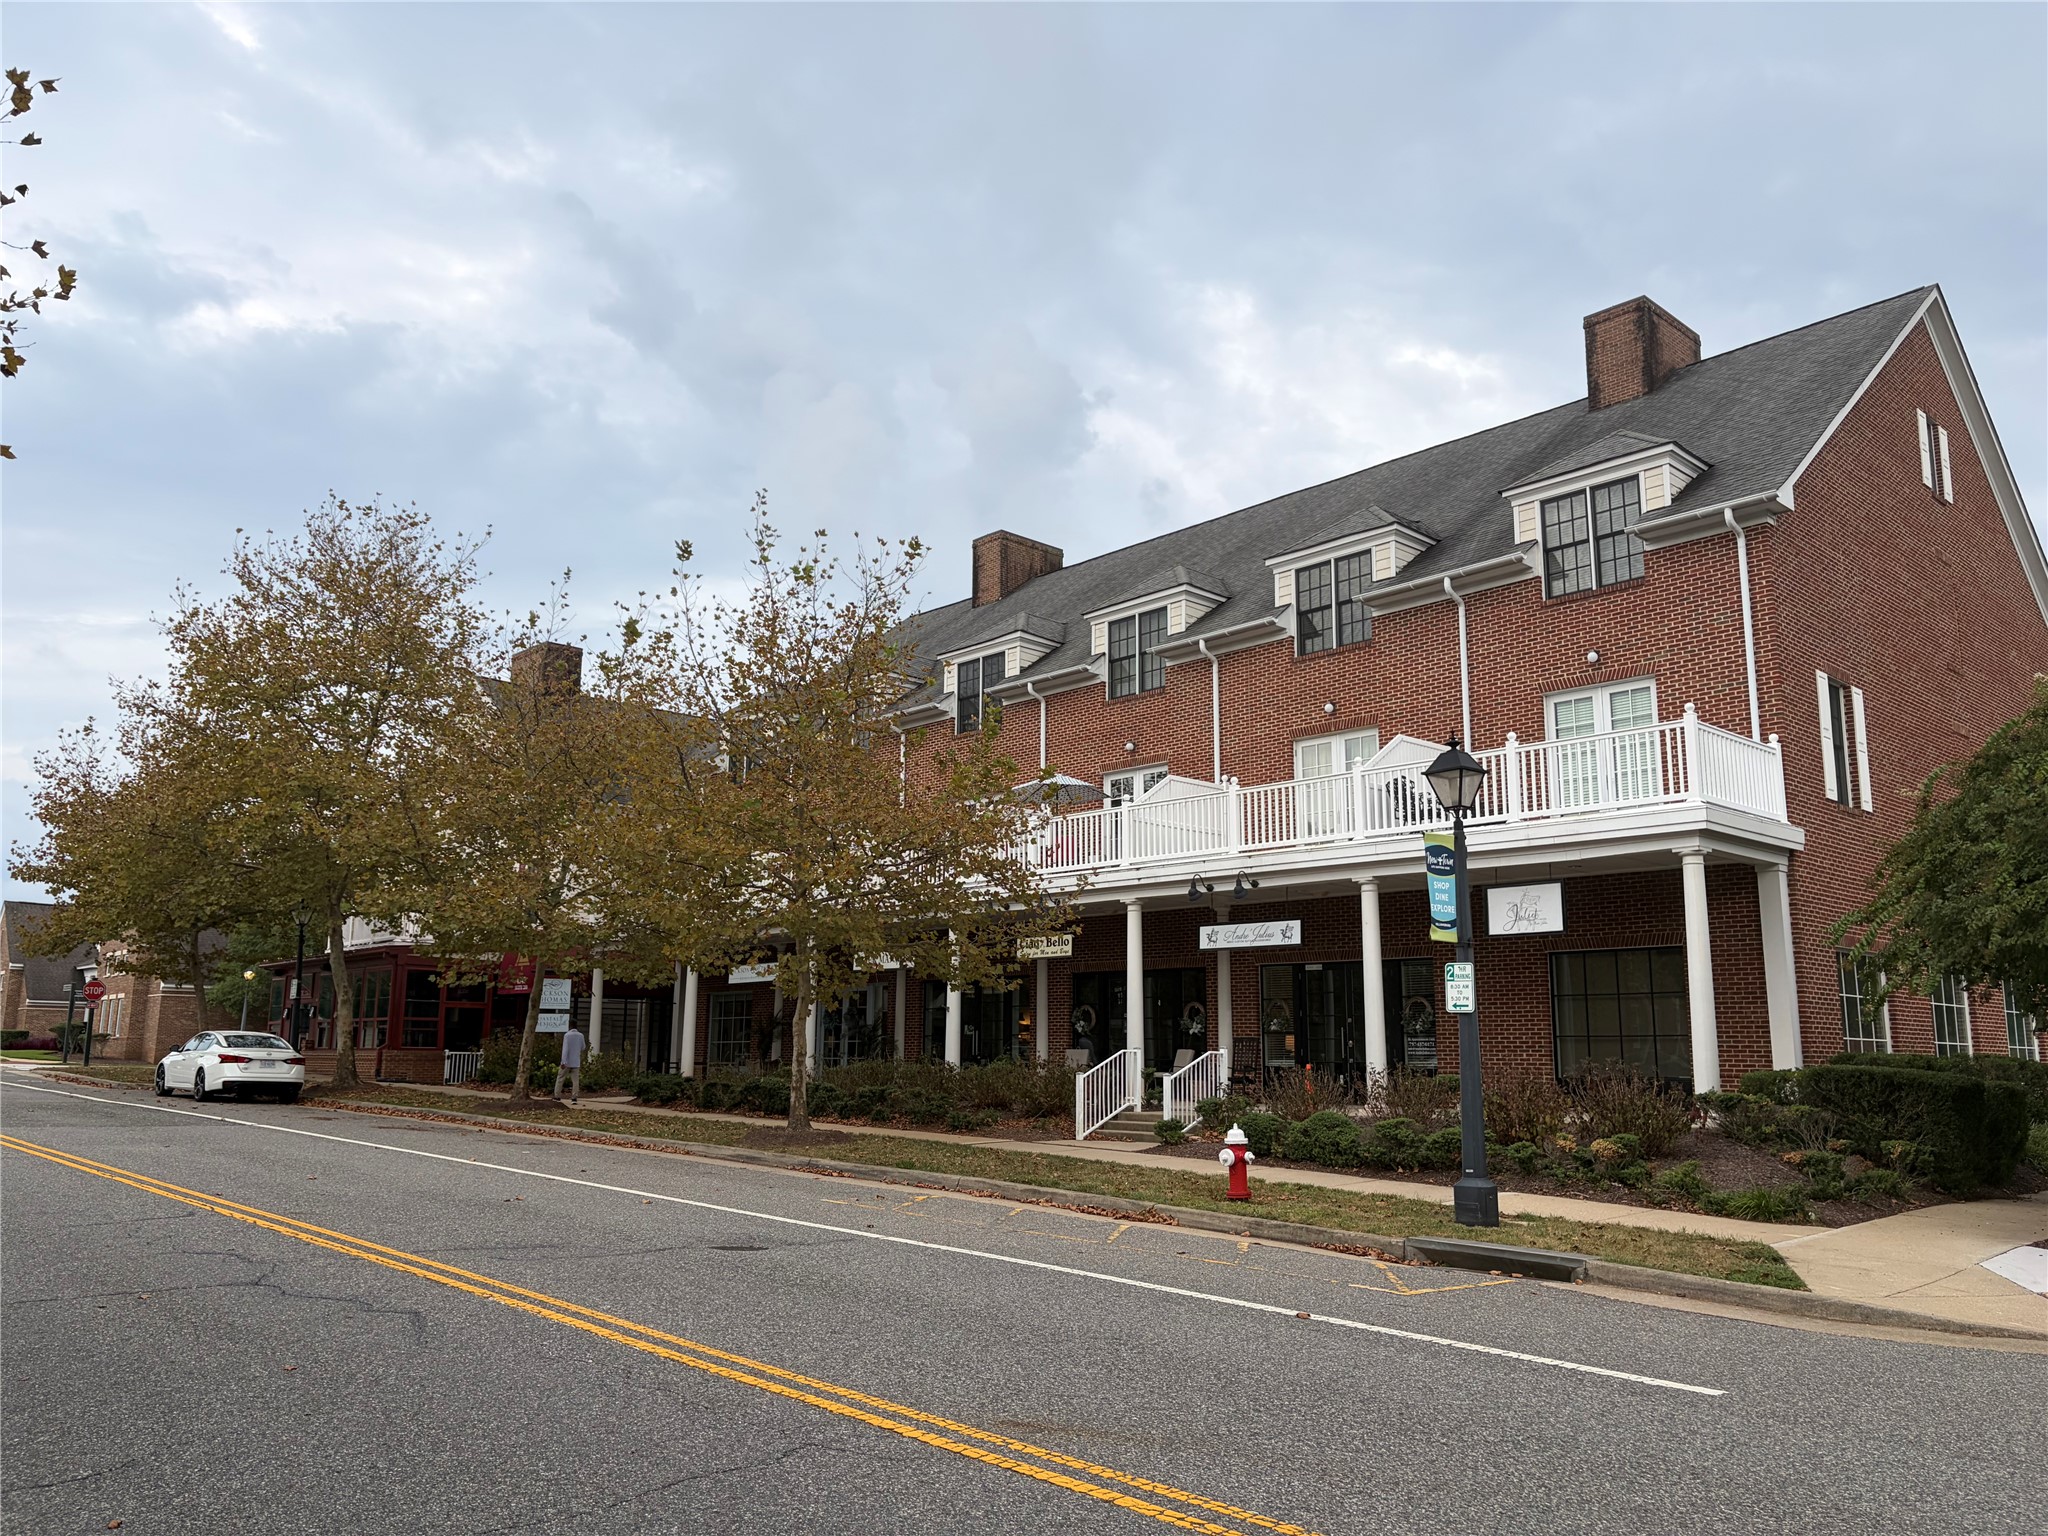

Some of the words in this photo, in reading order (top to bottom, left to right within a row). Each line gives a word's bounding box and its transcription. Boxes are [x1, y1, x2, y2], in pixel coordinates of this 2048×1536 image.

[1433, 881, 1450, 890] SHOP
[1435, 892, 1449, 901] DINE
[1431, 903, 1455, 914] EXPLORE
[1046, 937, 1069, 947] Bello
[1446, 966, 1454, 980] 2
[84, 986, 104, 995] STOP
